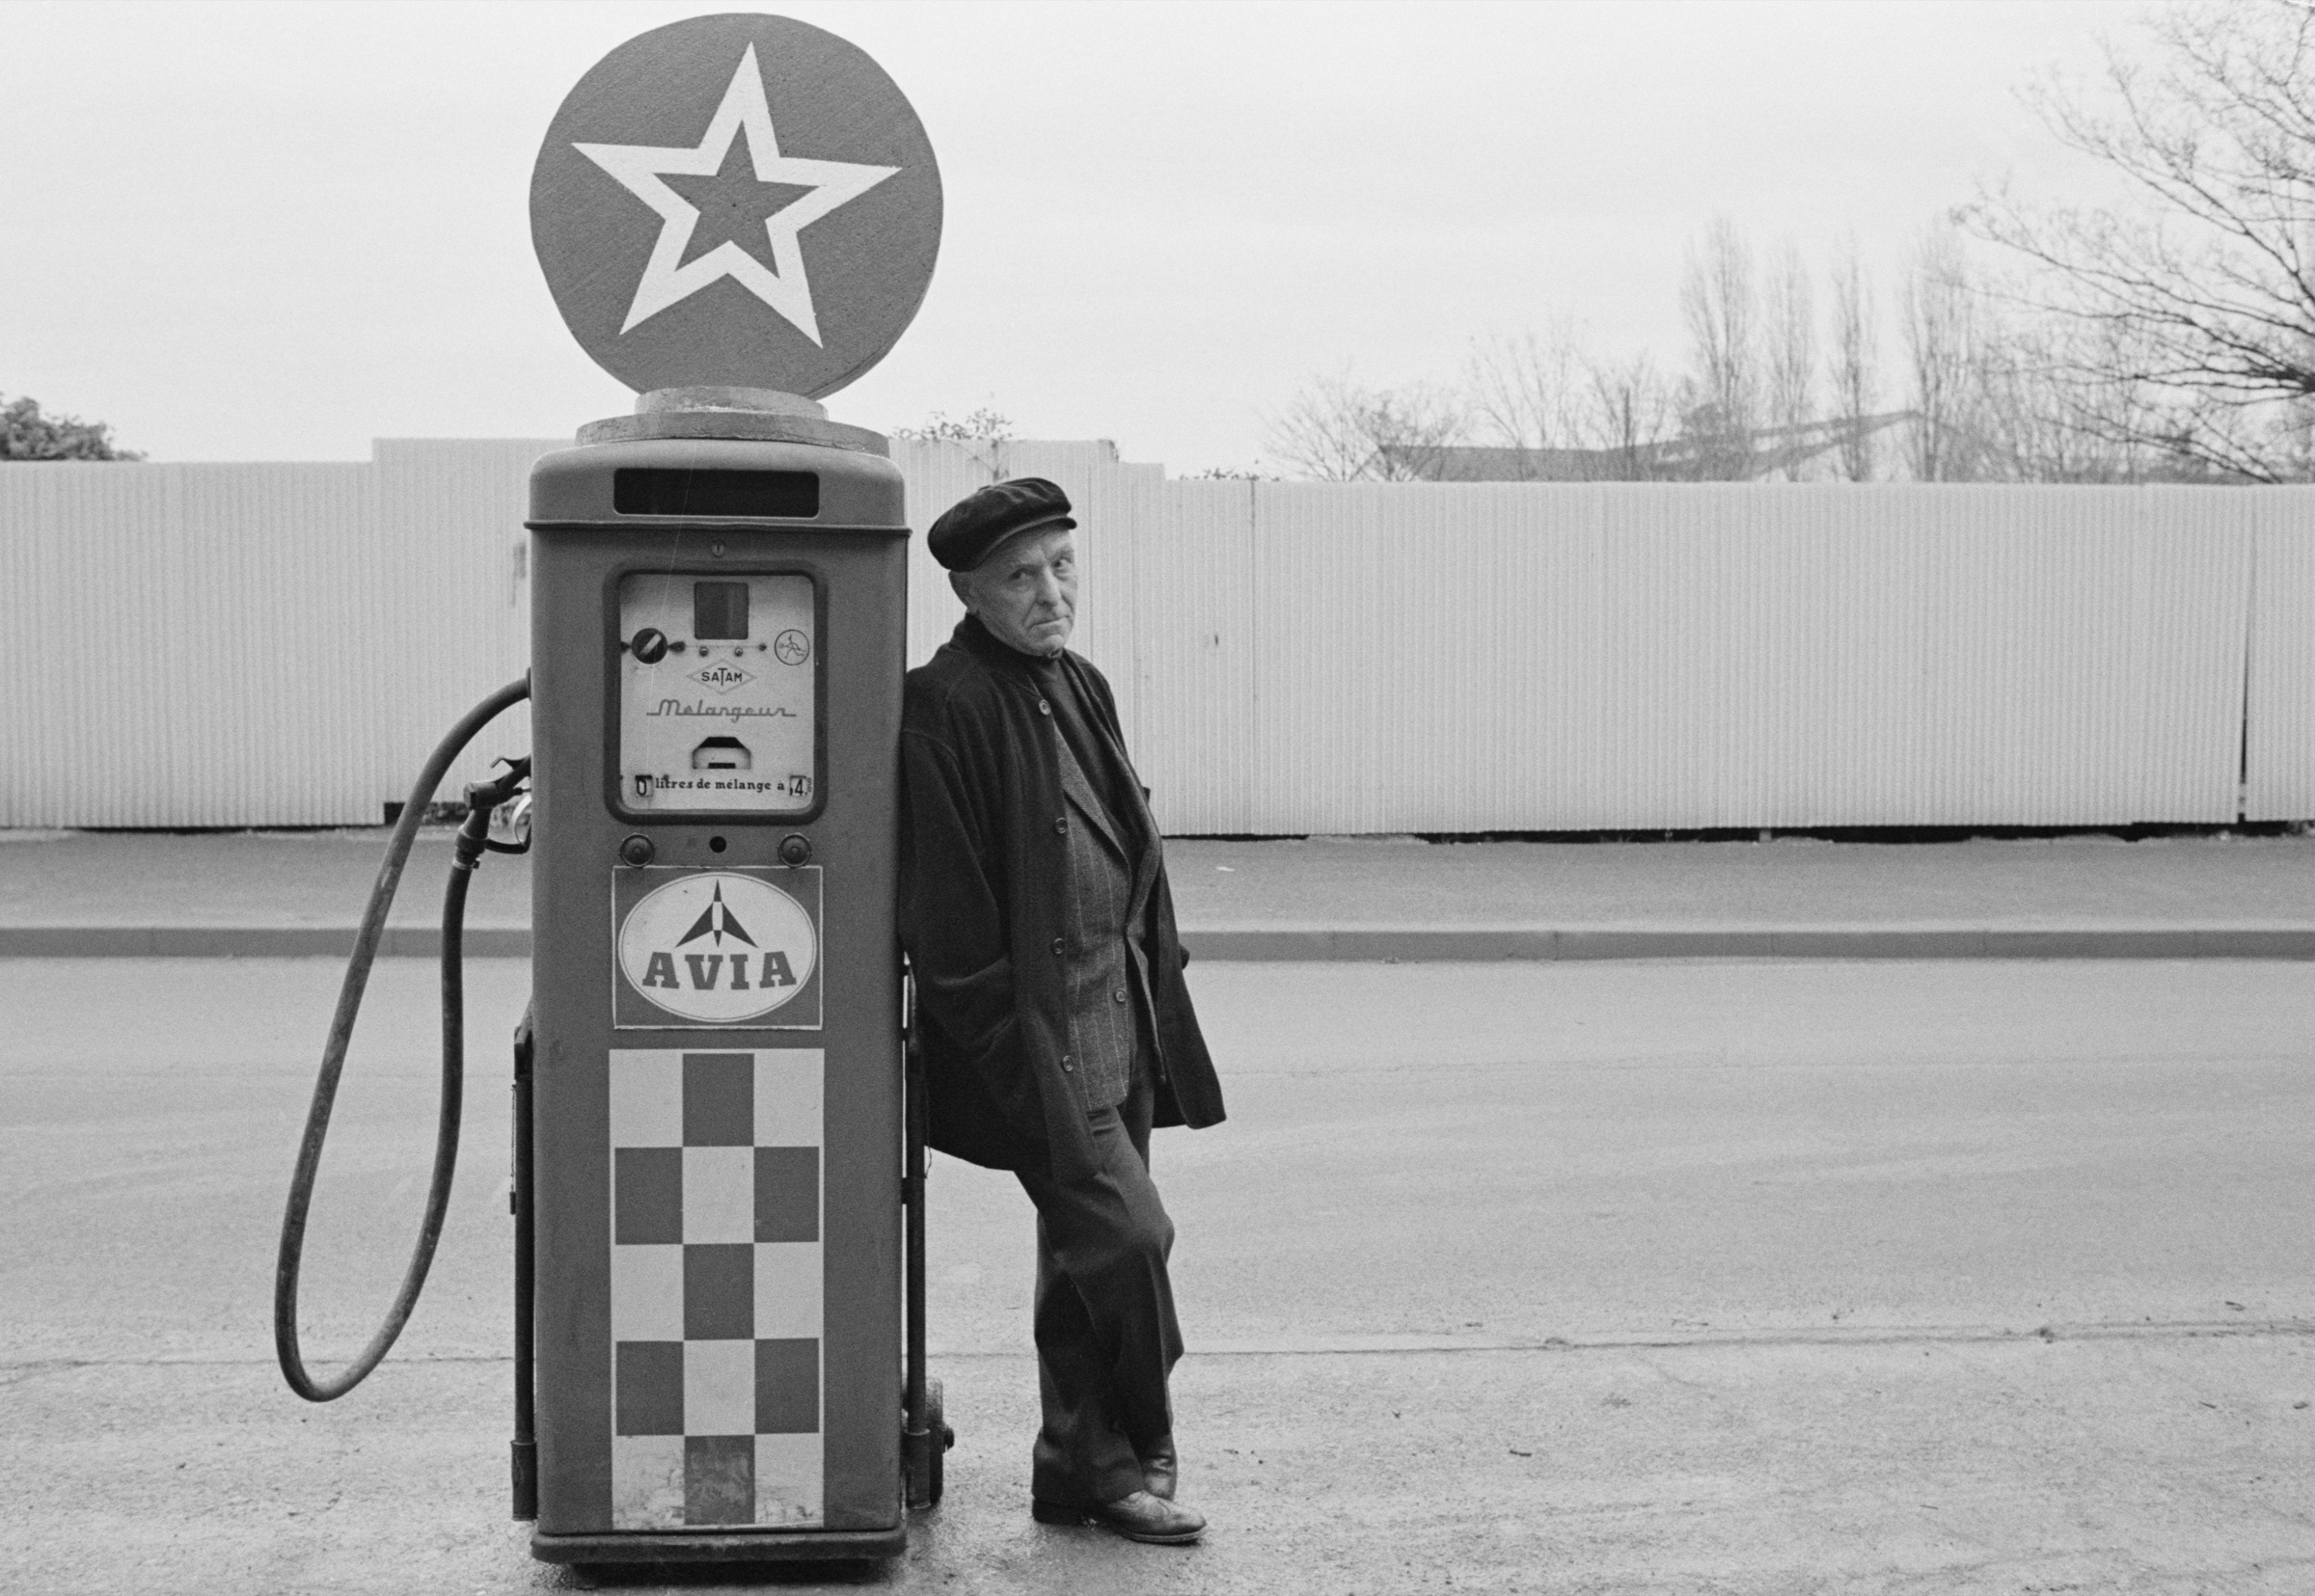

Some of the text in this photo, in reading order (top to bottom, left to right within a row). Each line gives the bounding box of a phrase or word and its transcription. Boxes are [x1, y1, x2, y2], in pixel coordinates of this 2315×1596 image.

[701, 667, 743, 687] SATAM
[655, 777, 694, 790] litres
[696, 777, 711, 789] de
[715, 778, 771, 793] mélange
[641, 951, 798, 990] AVIA
